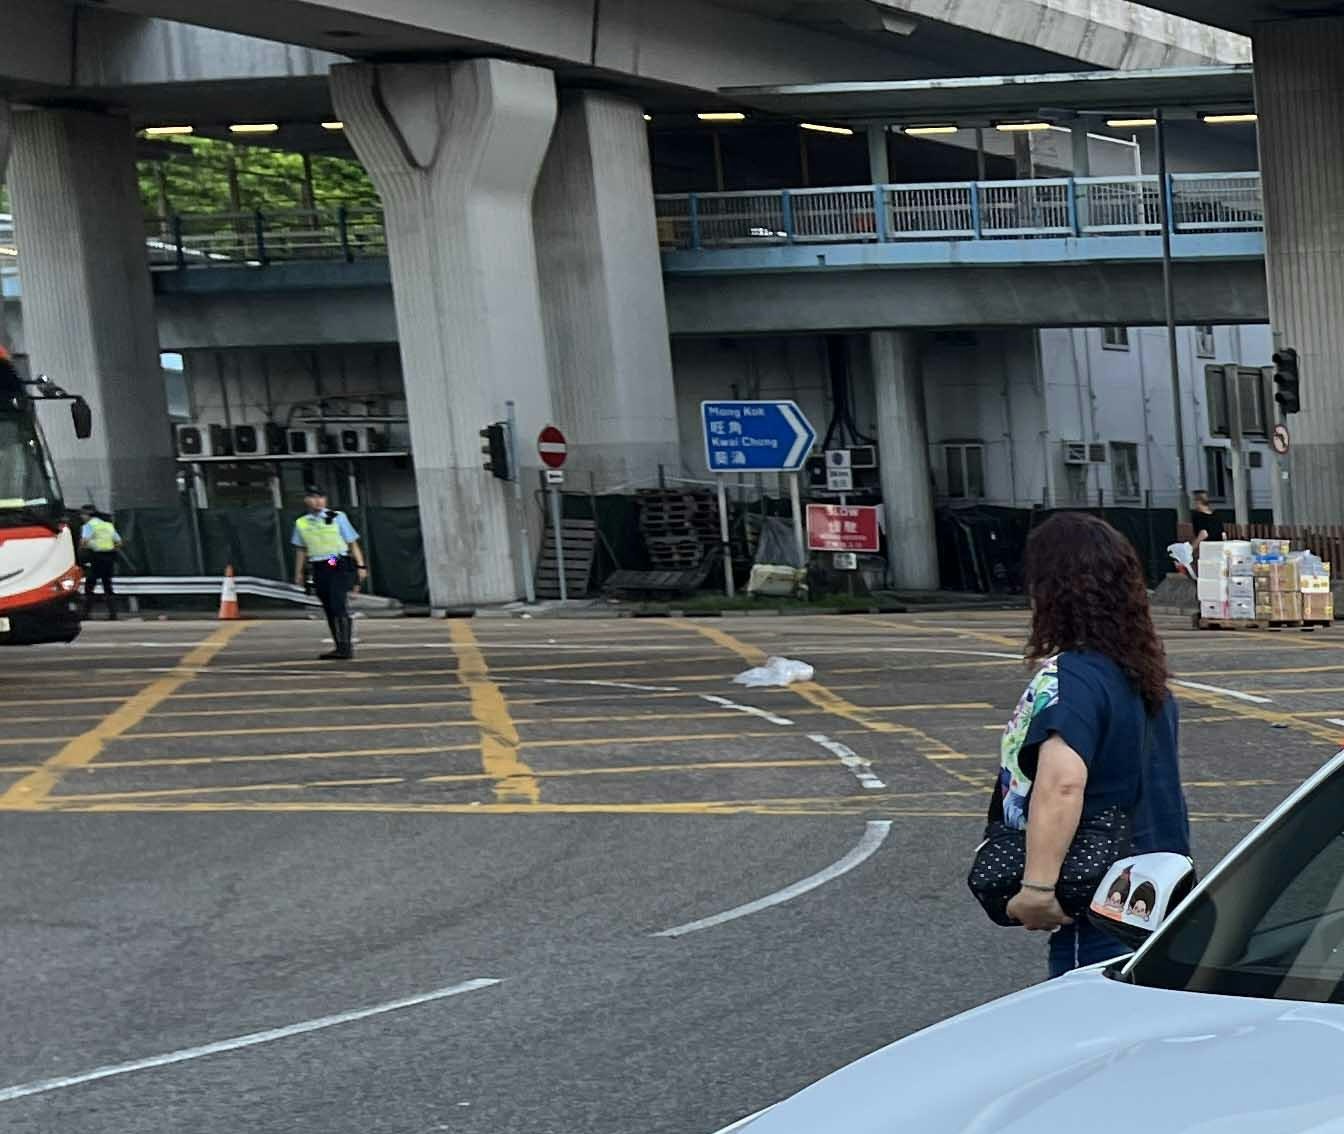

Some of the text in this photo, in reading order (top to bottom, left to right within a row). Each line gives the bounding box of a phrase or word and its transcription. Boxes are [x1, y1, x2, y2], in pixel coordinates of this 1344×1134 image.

[708, 406, 740, 418] Mong
[712, 436, 778, 448] Kwai Chung
